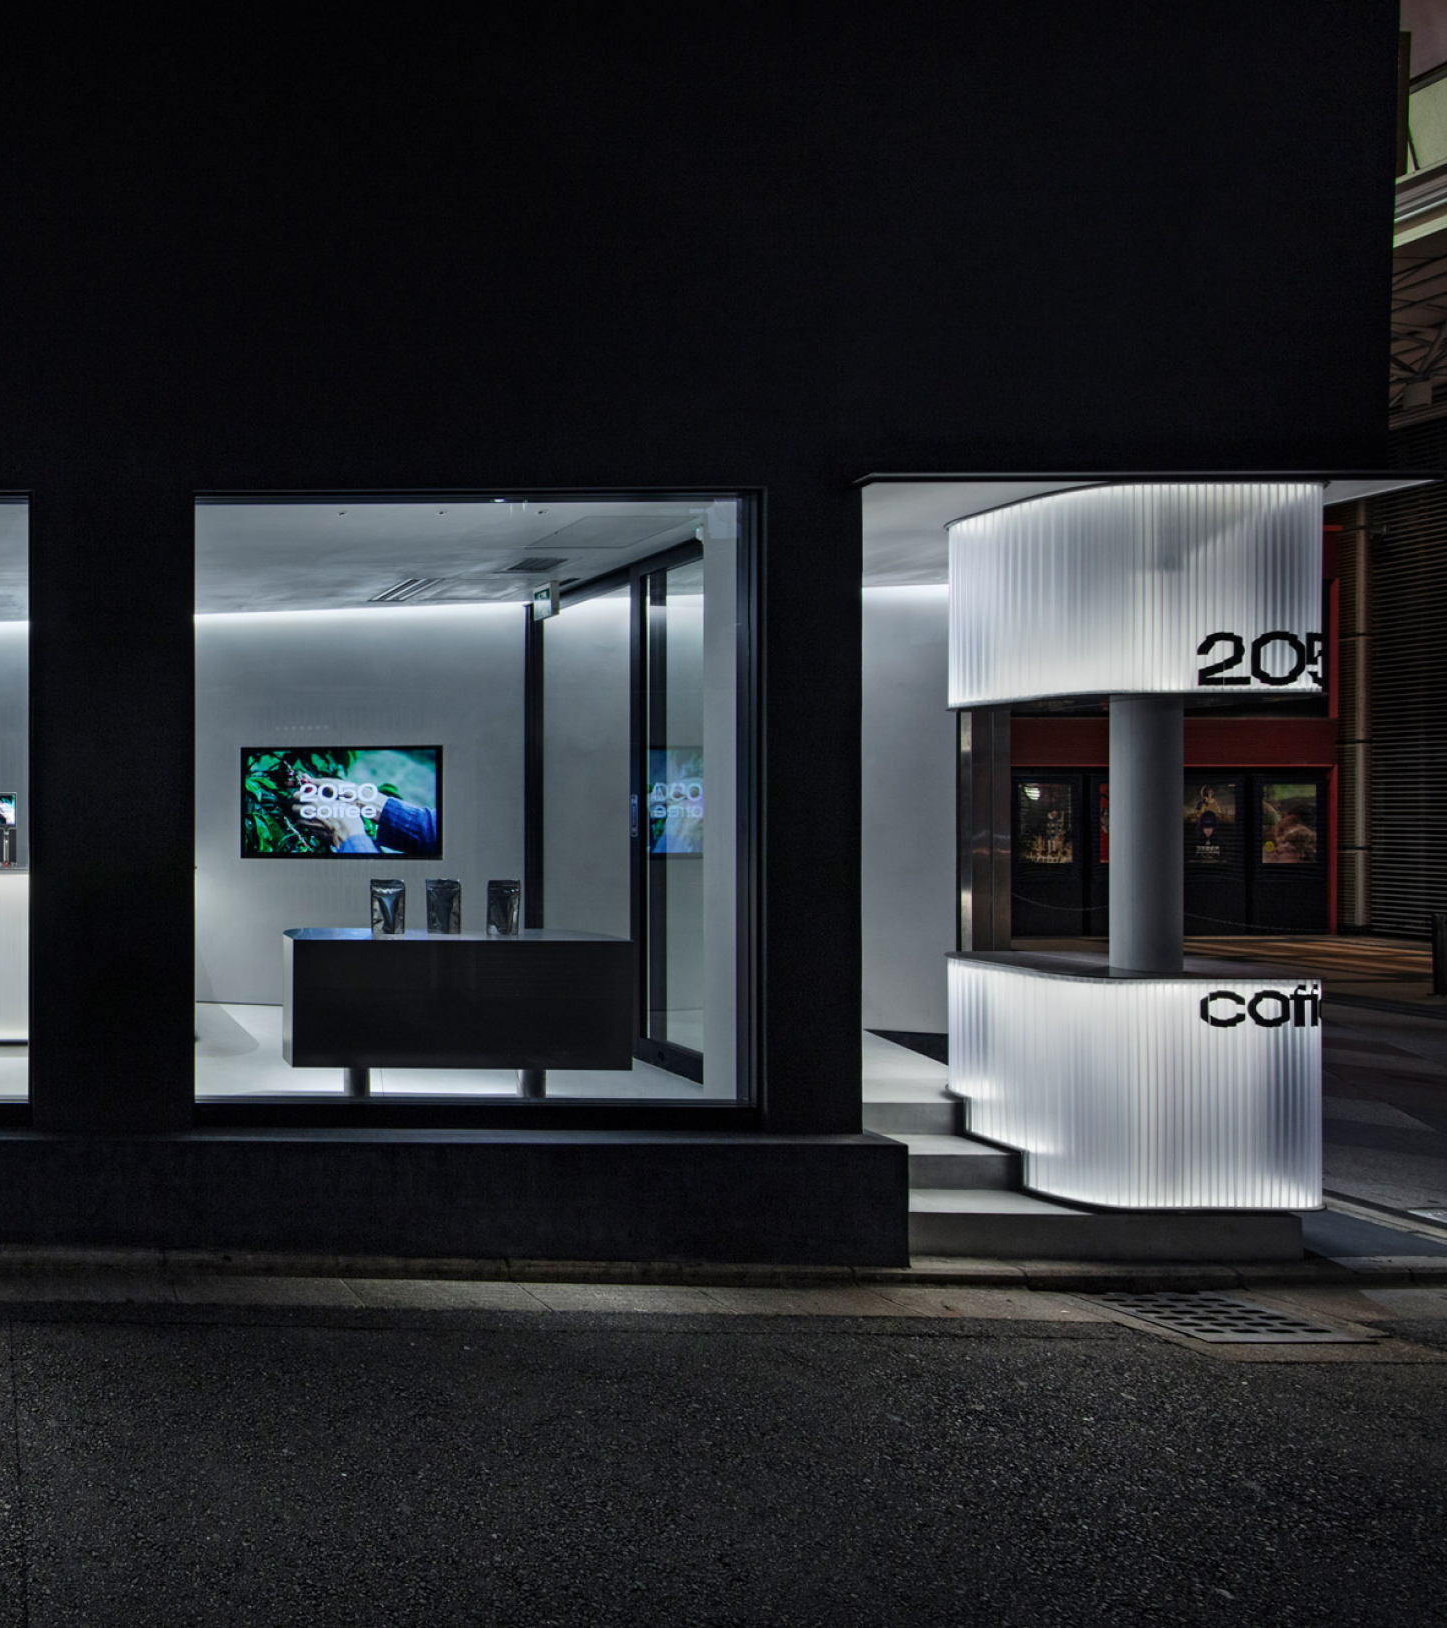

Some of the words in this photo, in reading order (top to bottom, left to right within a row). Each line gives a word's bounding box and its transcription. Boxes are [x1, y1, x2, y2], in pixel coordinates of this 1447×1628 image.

[299, 783, 378, 803] 2050
[299, 803, 377, 820] coffee
[1200, 984, 1321, 1028] coff
